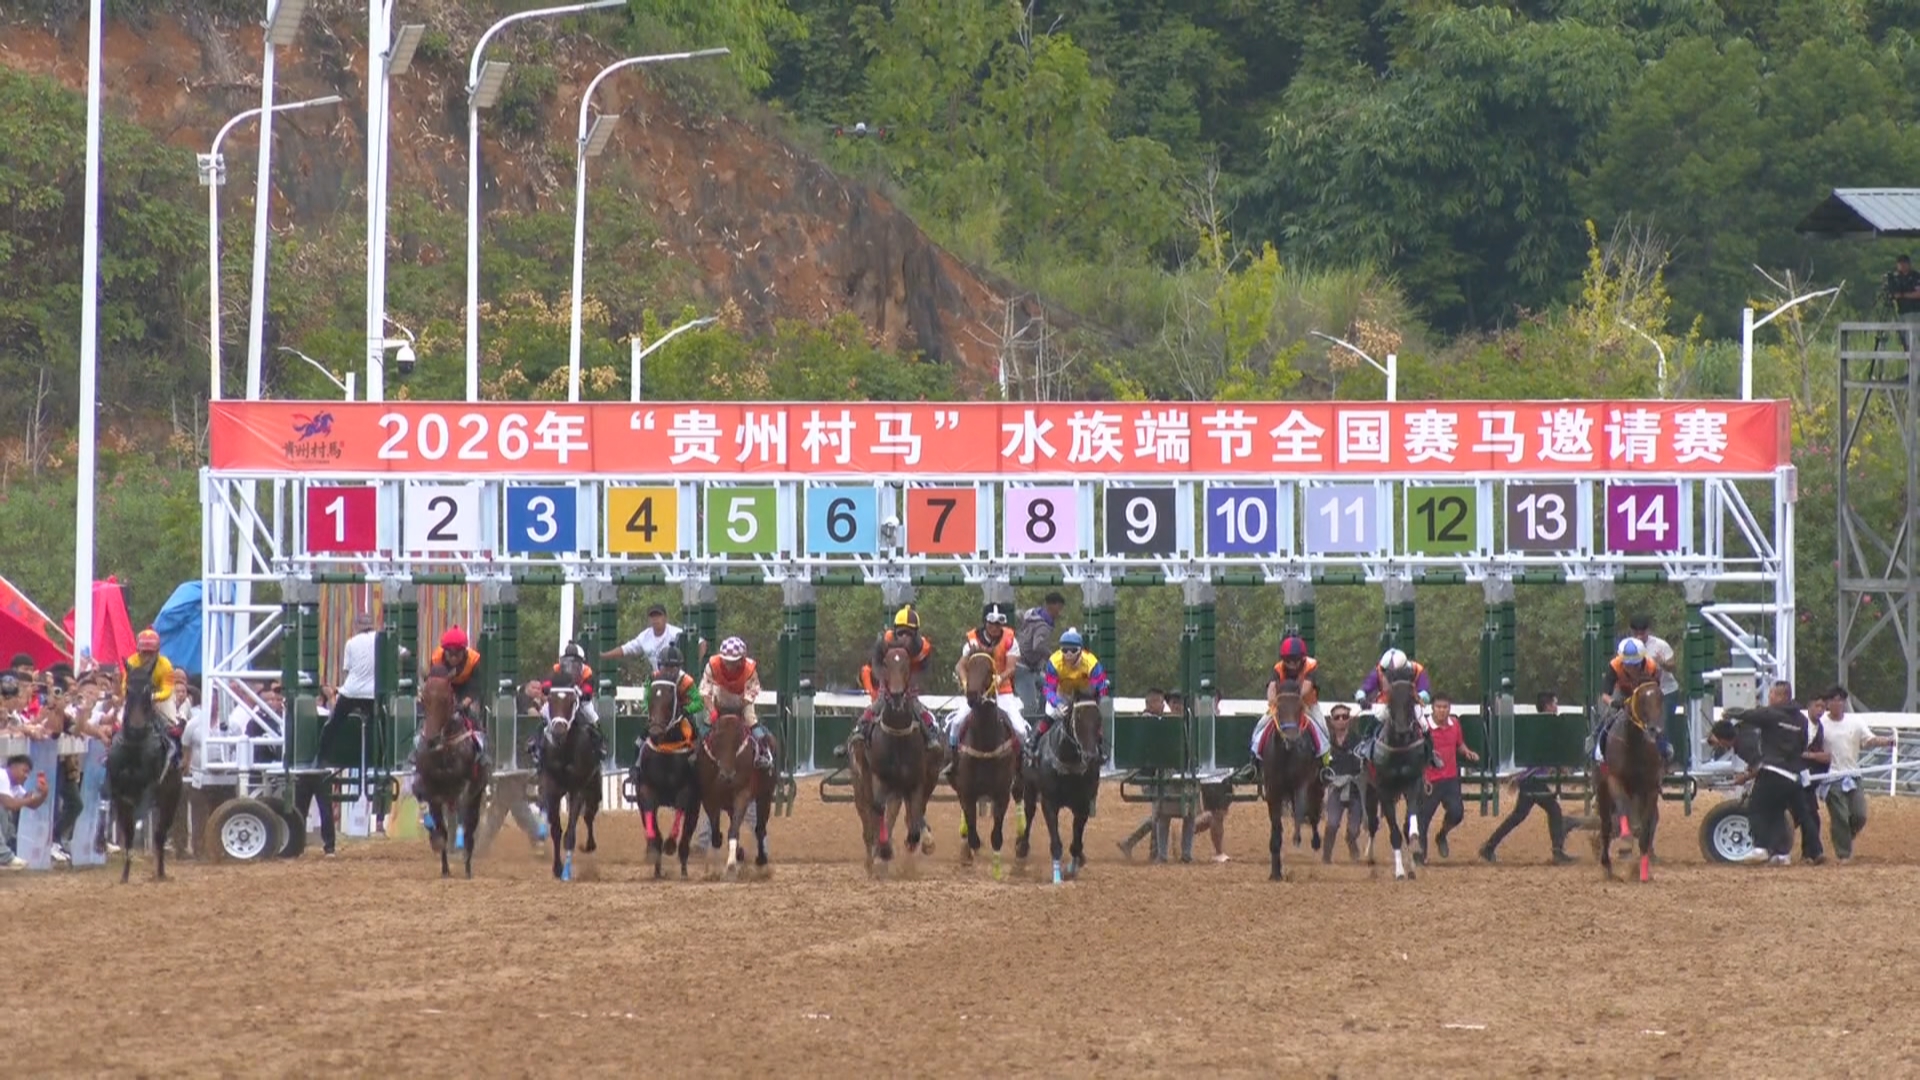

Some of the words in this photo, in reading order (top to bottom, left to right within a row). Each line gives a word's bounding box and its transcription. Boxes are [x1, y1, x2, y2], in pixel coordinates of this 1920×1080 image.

[377, 409, 589, 465] 2026年
[1001, 407, 1729, 466] 水族端节全国赛马邀请赛
[326, 496, 344, 543] 1
[427, 496, 458, 541] 2
[527, 496, 557, 543] 3
[626, 497, 657, 543] 4
[727, 497, 757, 544] 5
[826, 498, 857, 543] 6
[927, 498, 957, 543] 7
[1026, 498, 1056, 544] 8
[1126, 497, 1157, 544] 9
[1216, 497, 1267, 544] 10
[1319, 497, 1364, 543] 11
[1416, 496, 1468, 542] 12
[1516, 494, 1567, 540] 13
[1617, 495, 1669, 541] 14
